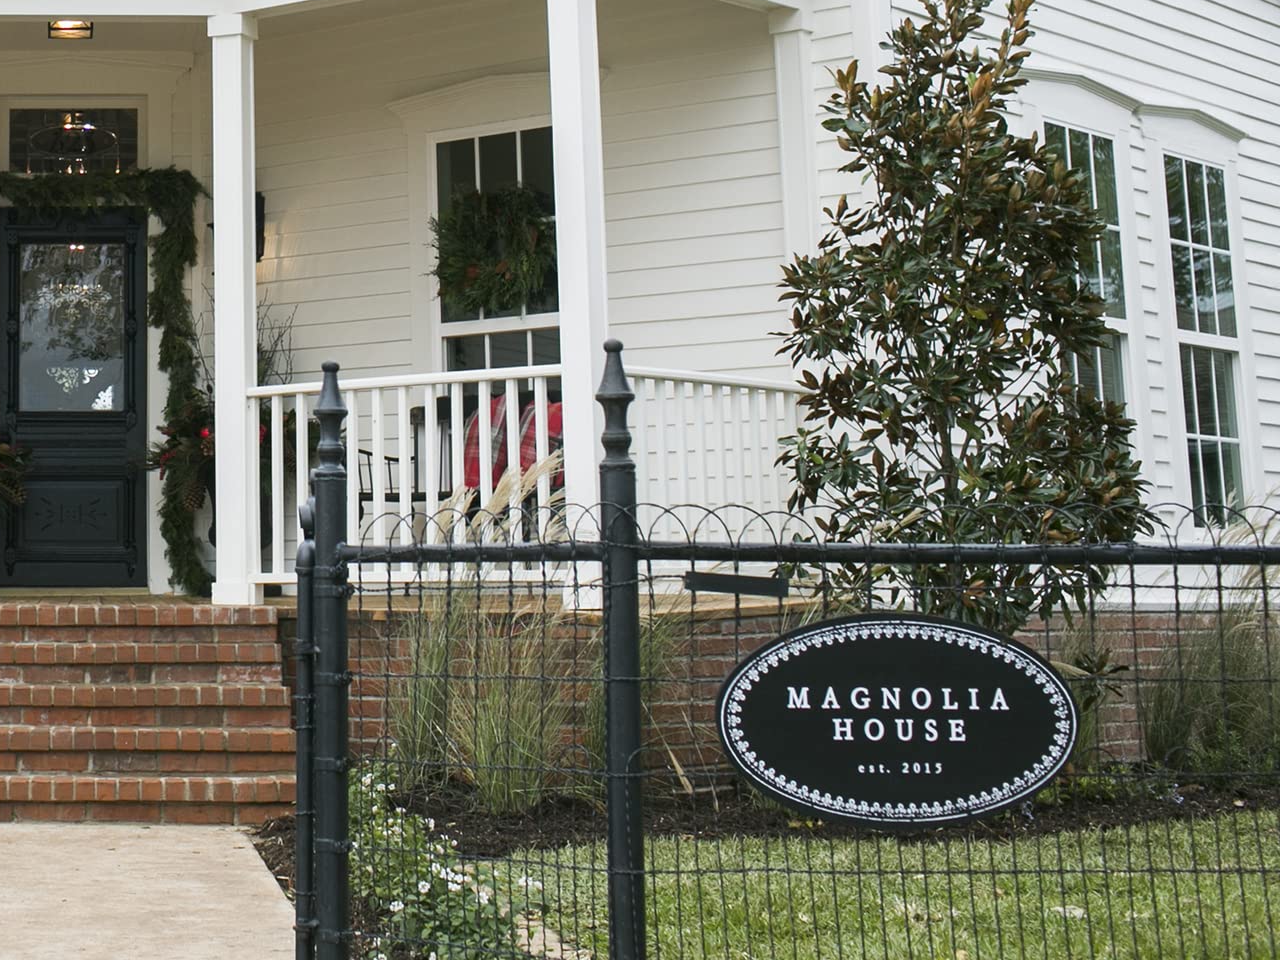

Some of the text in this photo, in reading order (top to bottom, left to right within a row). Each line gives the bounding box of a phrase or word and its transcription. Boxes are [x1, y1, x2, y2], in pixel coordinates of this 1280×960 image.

[786, 686, 1010, 711] MAGNOLIA
[832, 718, 967, 742] HOUSE
[857, 762, 943, 775] est. 2015
